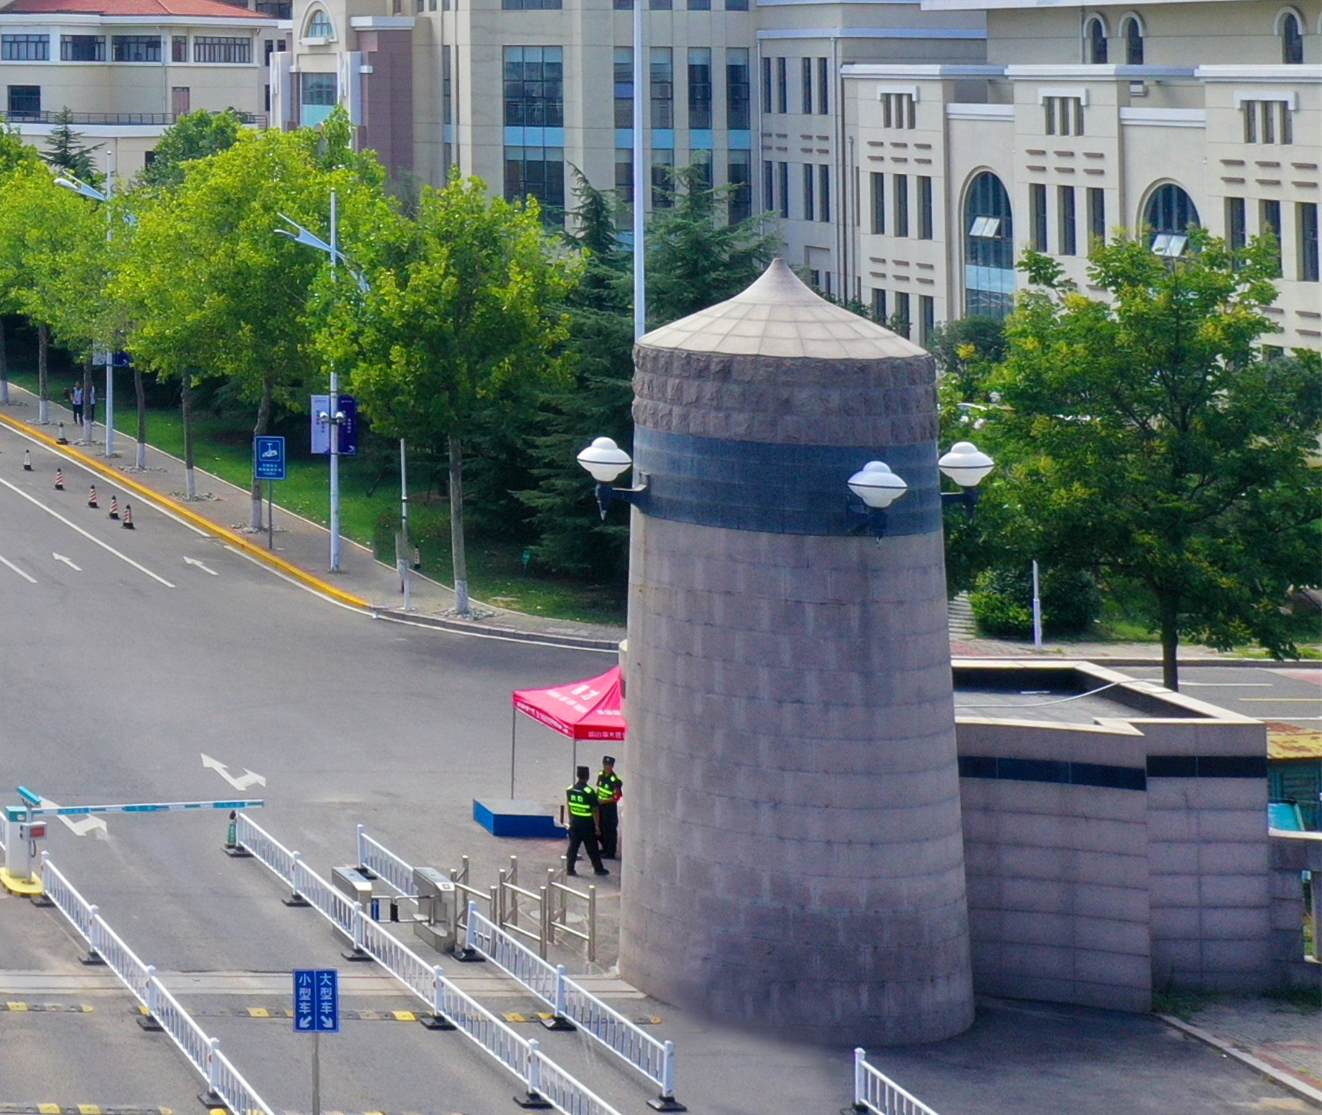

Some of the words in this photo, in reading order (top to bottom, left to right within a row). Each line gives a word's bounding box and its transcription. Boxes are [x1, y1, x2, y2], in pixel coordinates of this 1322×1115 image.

[298, 973, 312, 1014] 小型车
[319, 973, 333, 1014] 大型车
